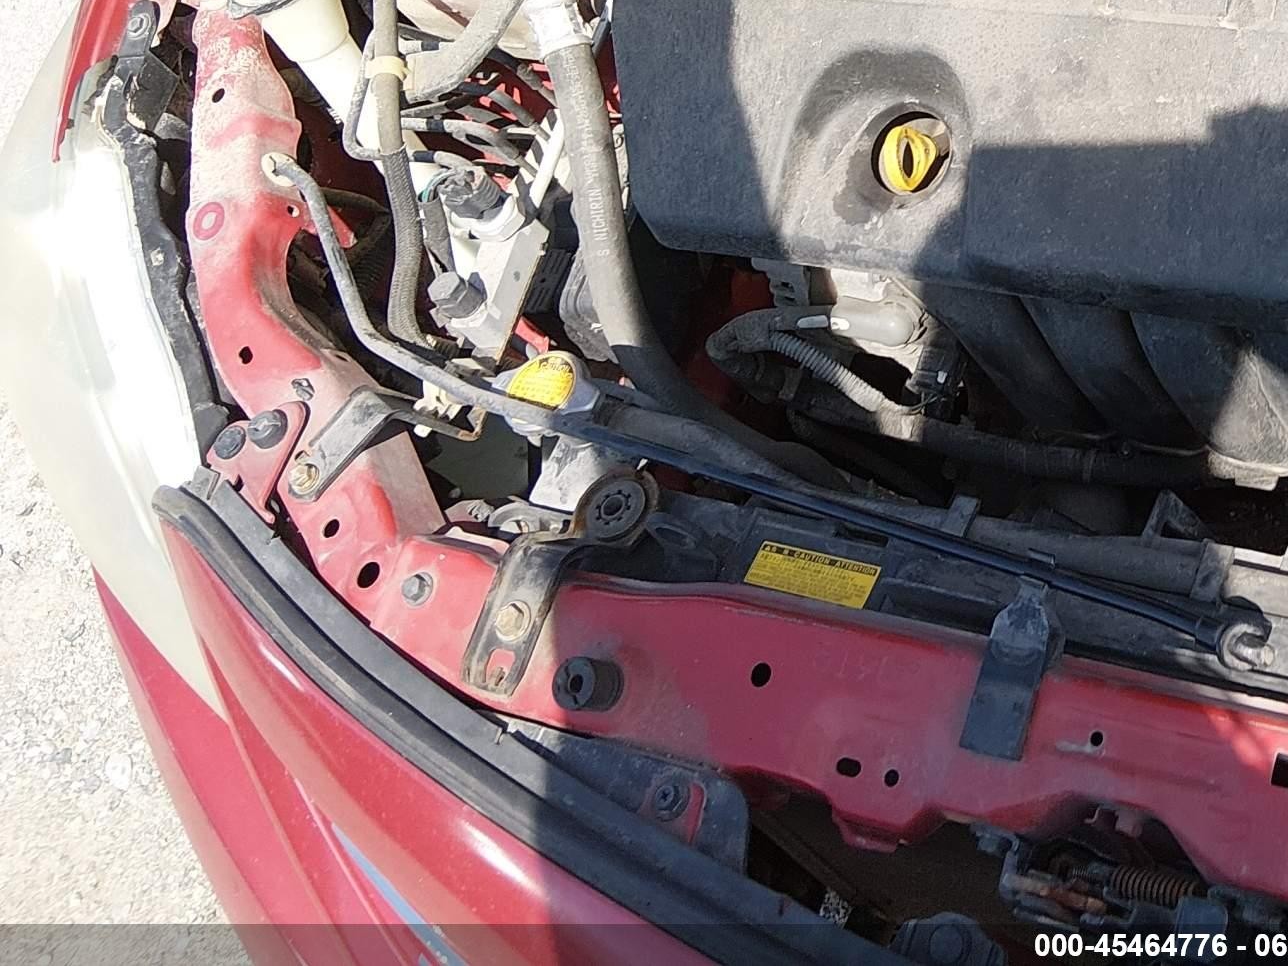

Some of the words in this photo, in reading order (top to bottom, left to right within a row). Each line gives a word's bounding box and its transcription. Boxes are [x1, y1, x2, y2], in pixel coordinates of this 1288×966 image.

[588, 188, 609, 241] NICHIRIN
[794, 550, 830, 565] CAUTION
[835, 561, 876, 575] ATTENTION
